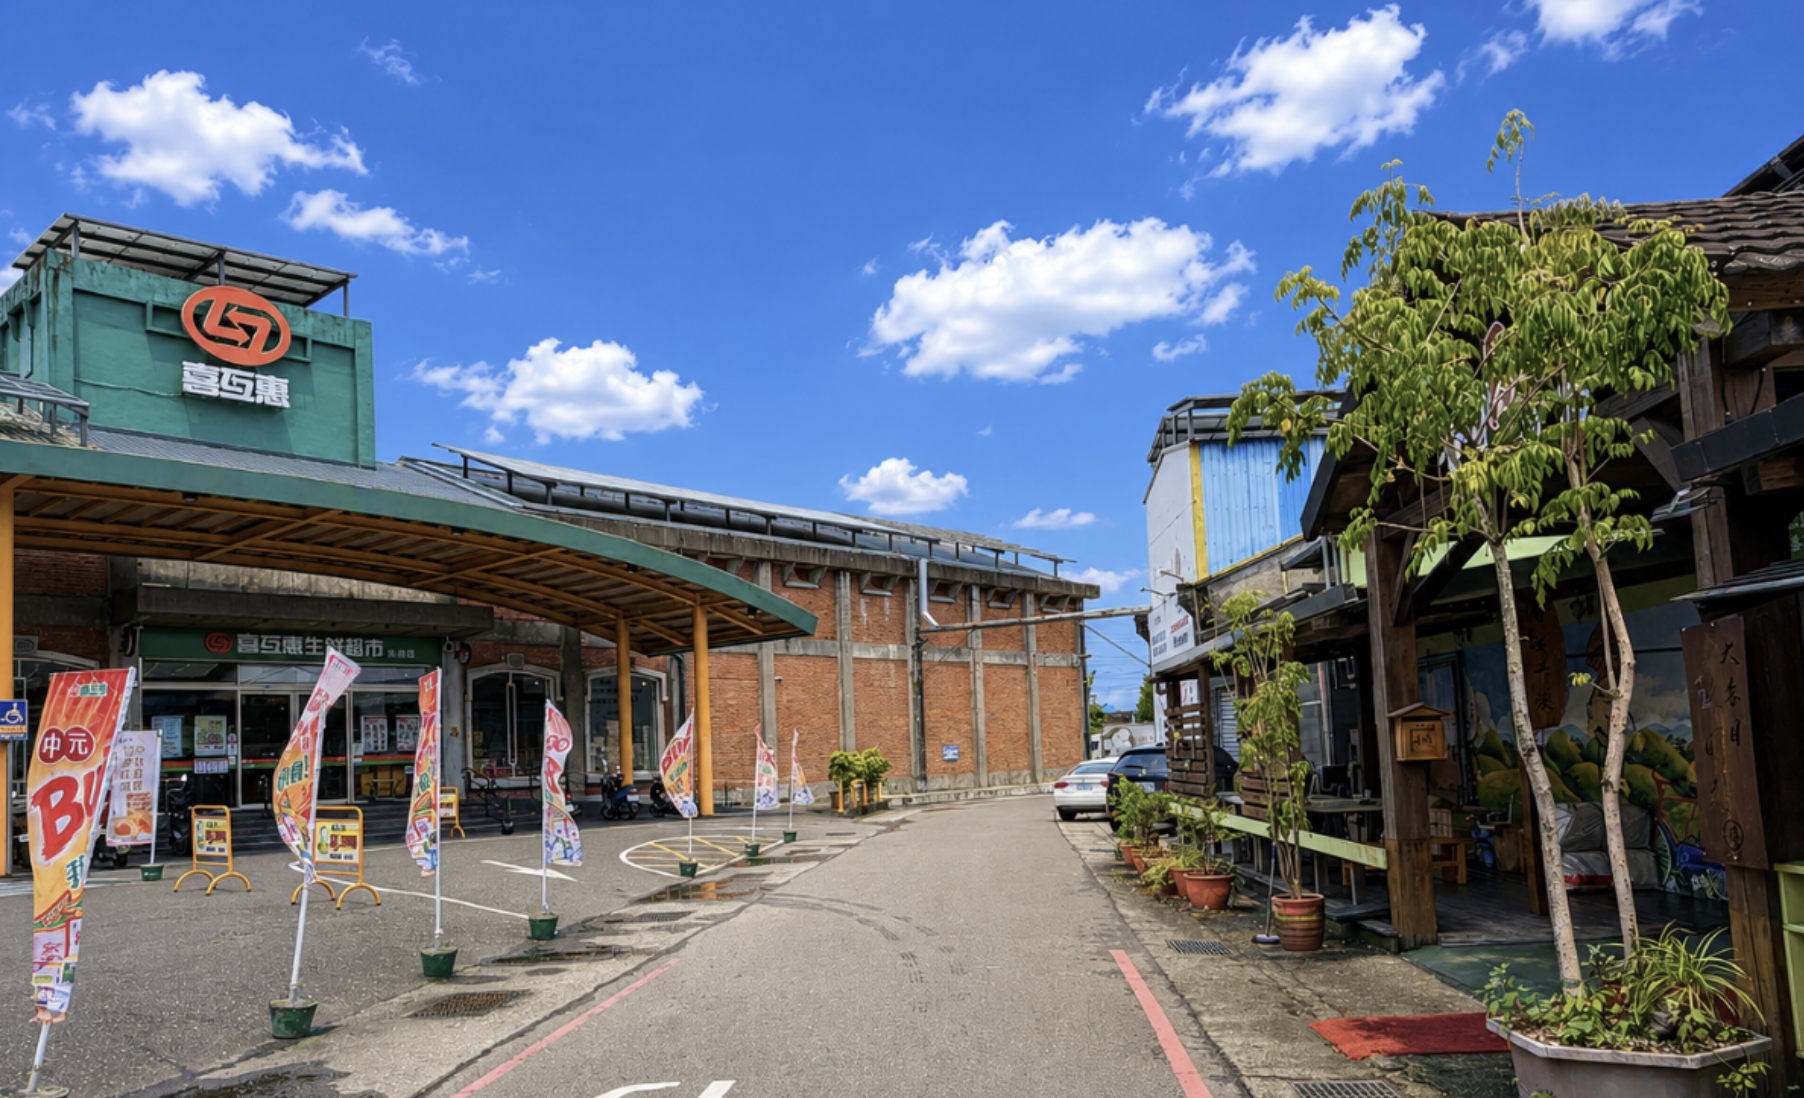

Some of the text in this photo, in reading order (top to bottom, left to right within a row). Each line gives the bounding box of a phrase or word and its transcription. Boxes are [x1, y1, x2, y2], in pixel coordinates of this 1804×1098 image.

[182, 361, 290, 408] 喜互惠
[42, 732, 88, 759] 中元
